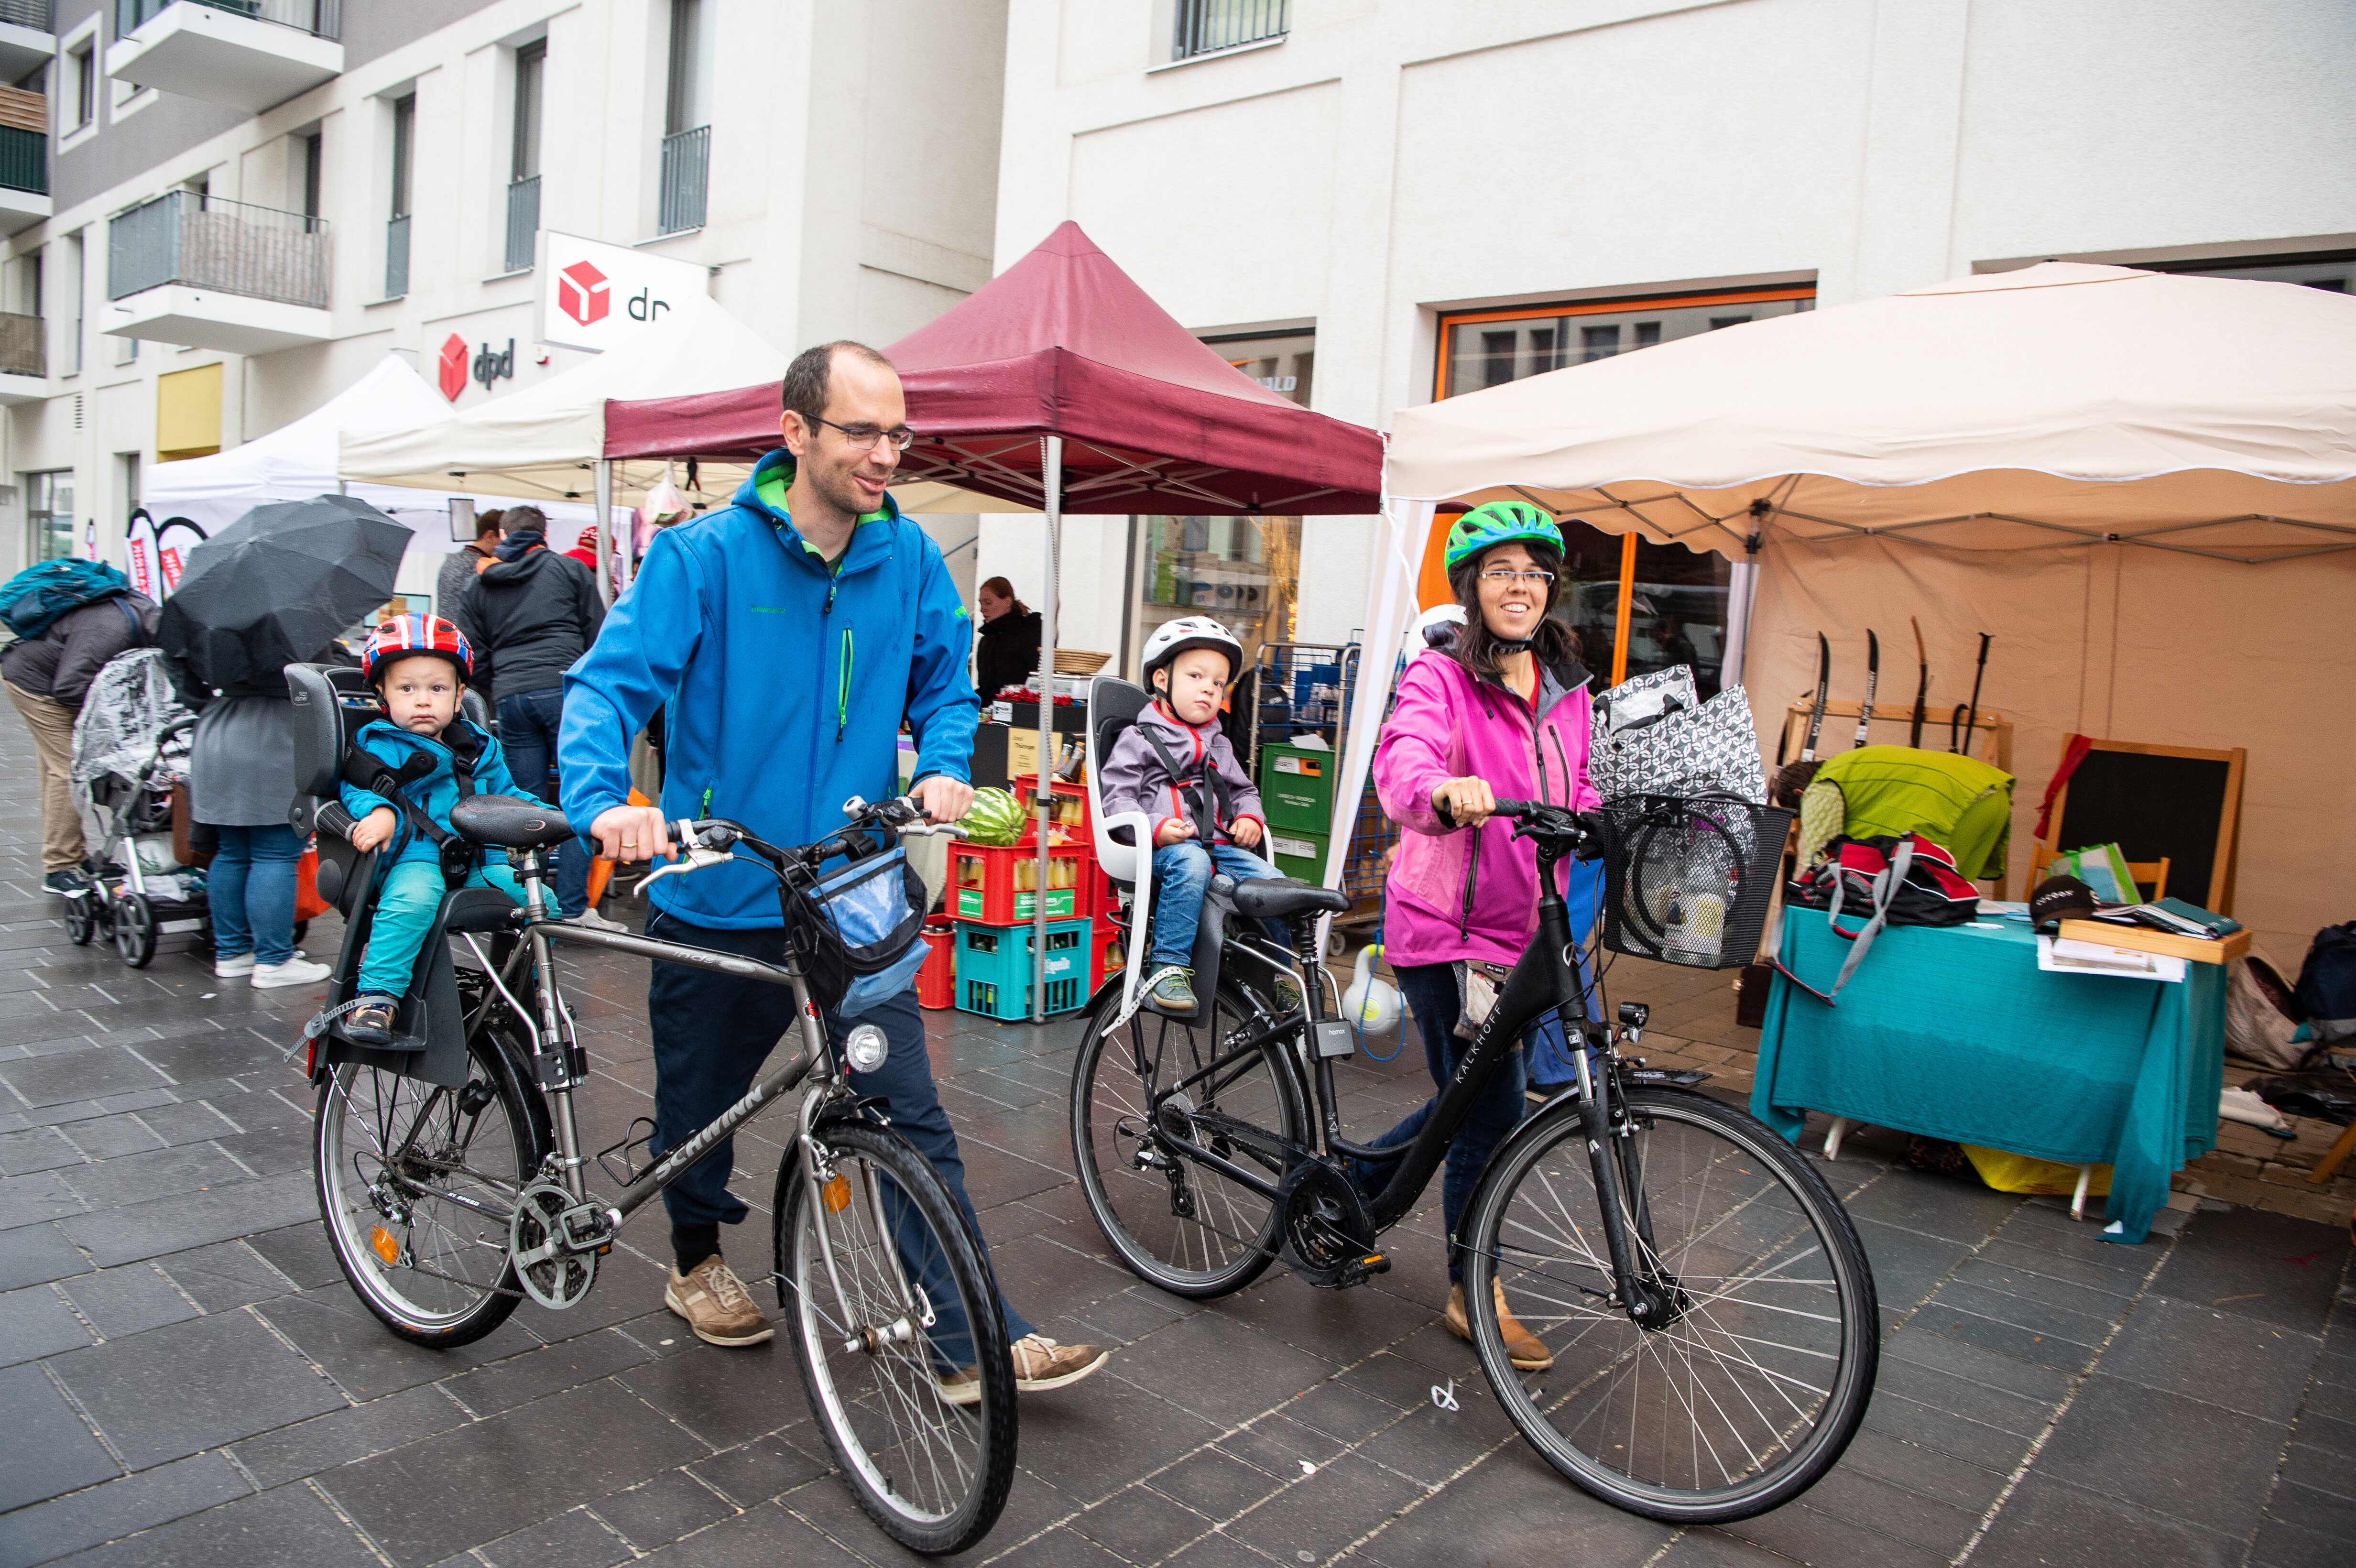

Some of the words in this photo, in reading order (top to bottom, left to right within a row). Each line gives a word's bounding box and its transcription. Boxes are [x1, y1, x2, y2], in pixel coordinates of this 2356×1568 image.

[474, 338, 514, 391] dpd
[1255, 376, 1297, 392] ALD
[1455, 1004, 1501, 1083] KALKHOFF
[655, 1083, 764, 1181] SCHWINN
[457, 1195, 480, 1206] SPEED
